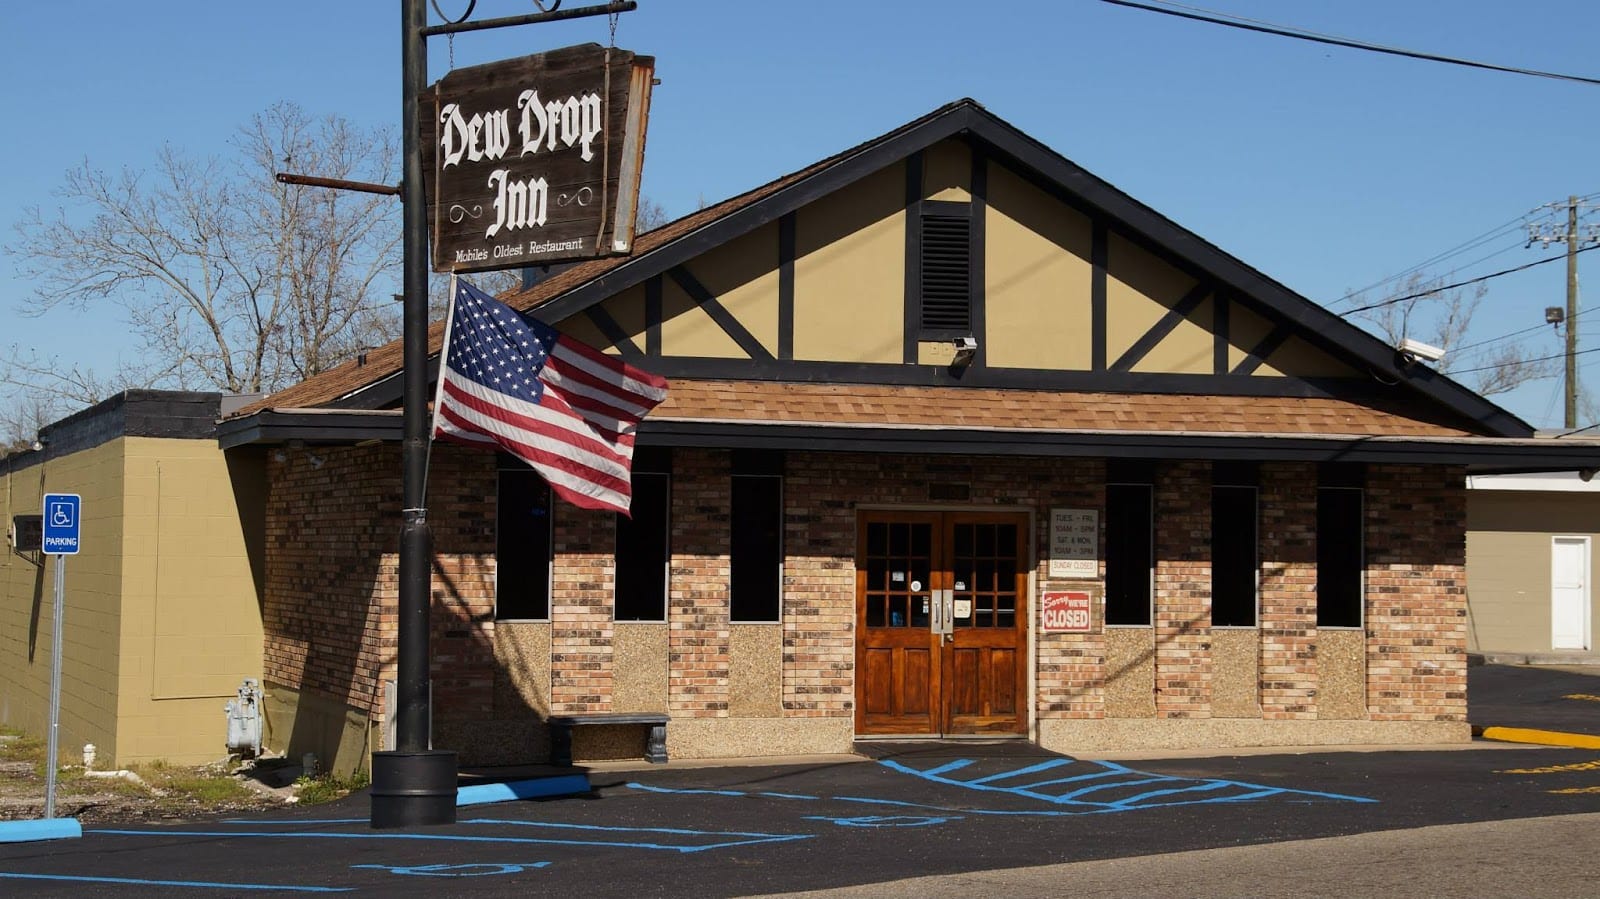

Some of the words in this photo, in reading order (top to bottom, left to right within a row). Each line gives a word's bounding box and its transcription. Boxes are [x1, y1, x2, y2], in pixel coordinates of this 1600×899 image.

[440, 103, 510, 170] Dew
[517, 89, 602, 162] Drop
[485, 169, 549, 240] Inn
[455, 249, 488, 263] Mobile's
[493, 244, 523, 257] Oldest
[529, 238, 583, 254] Restaurant
[45, 537, 77, 546] PARKING
[1053, 561, 1072, 569] SUNDAY
[1073, 561, 1094, 570] CLOSED
[1044, 595, 1069, 609] Sorry
[1044, 610, 1088, 628] CLOSED
